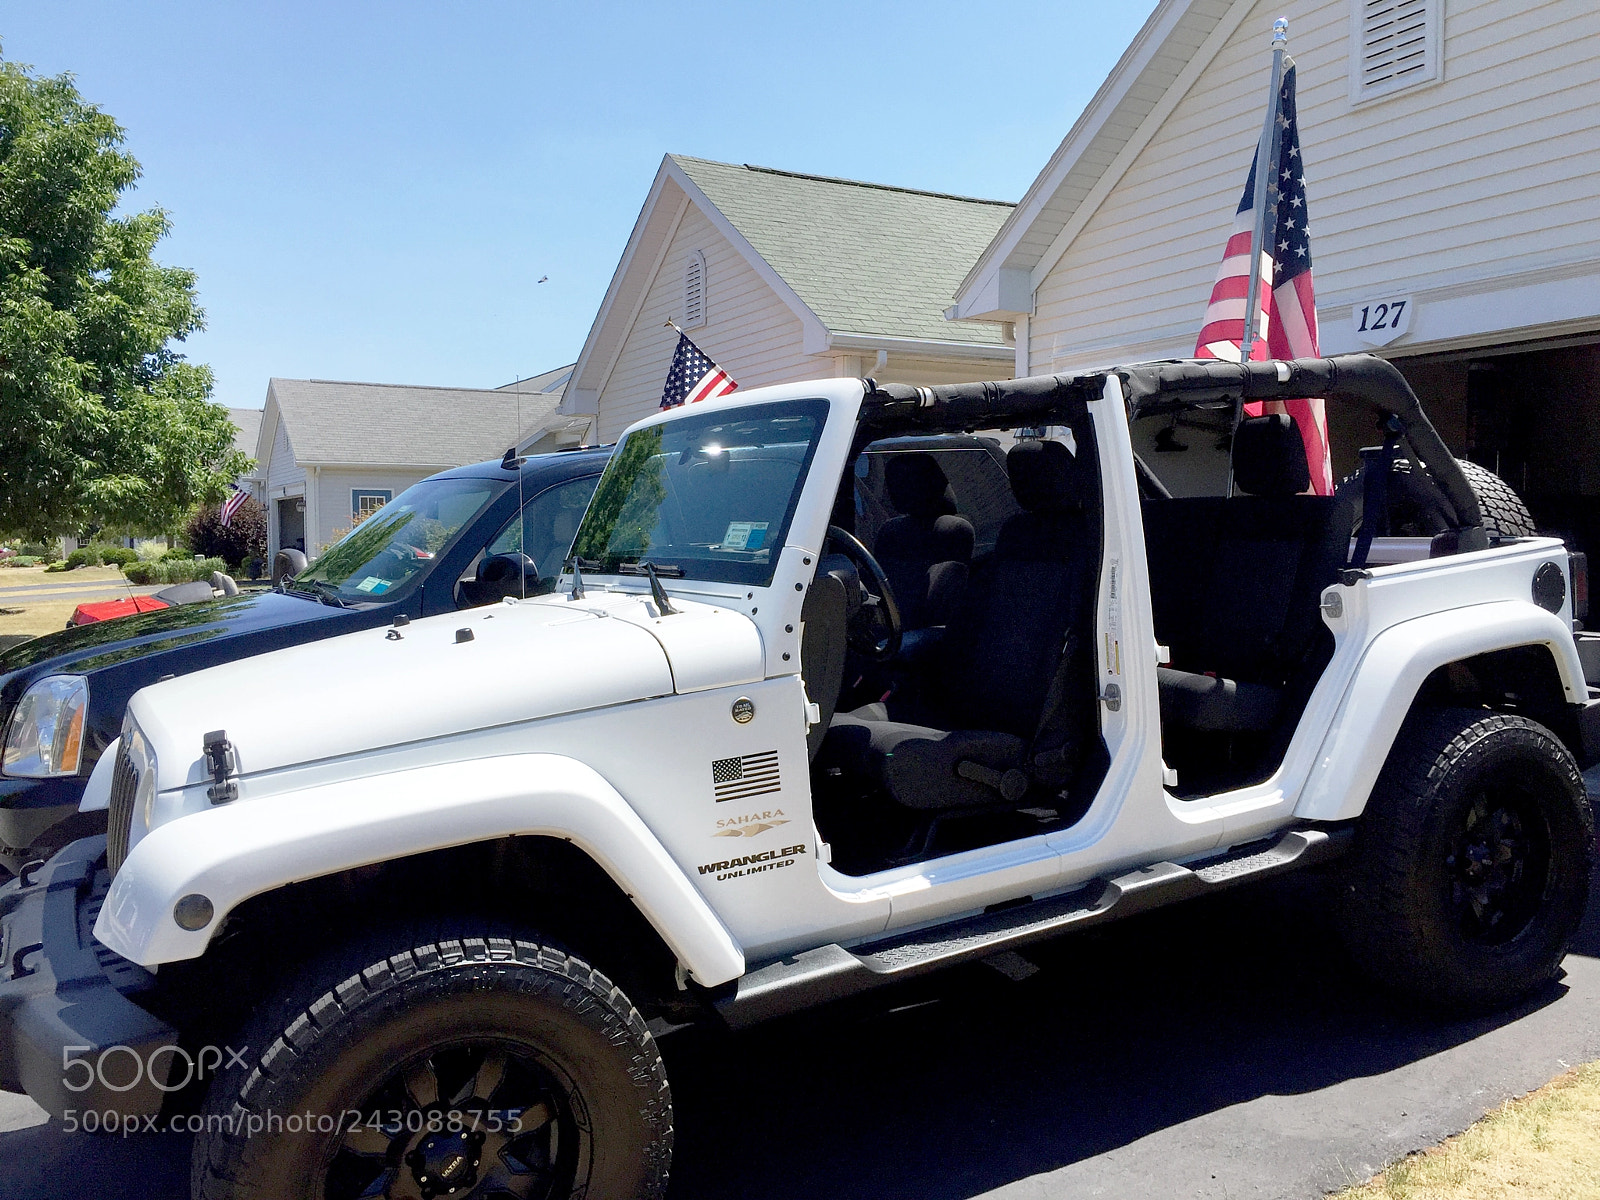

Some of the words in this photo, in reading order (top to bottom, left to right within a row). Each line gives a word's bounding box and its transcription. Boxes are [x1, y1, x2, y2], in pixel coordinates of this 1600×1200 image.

[1358, 301, 1407, 332] 127
[716, 809, 785, 828] SAHARA
[698, 844, 807, 875] WRANGLER
[717, 859, 795, 881] UNLIMITED
[441, 1156, 464, 1177] ULTRA
